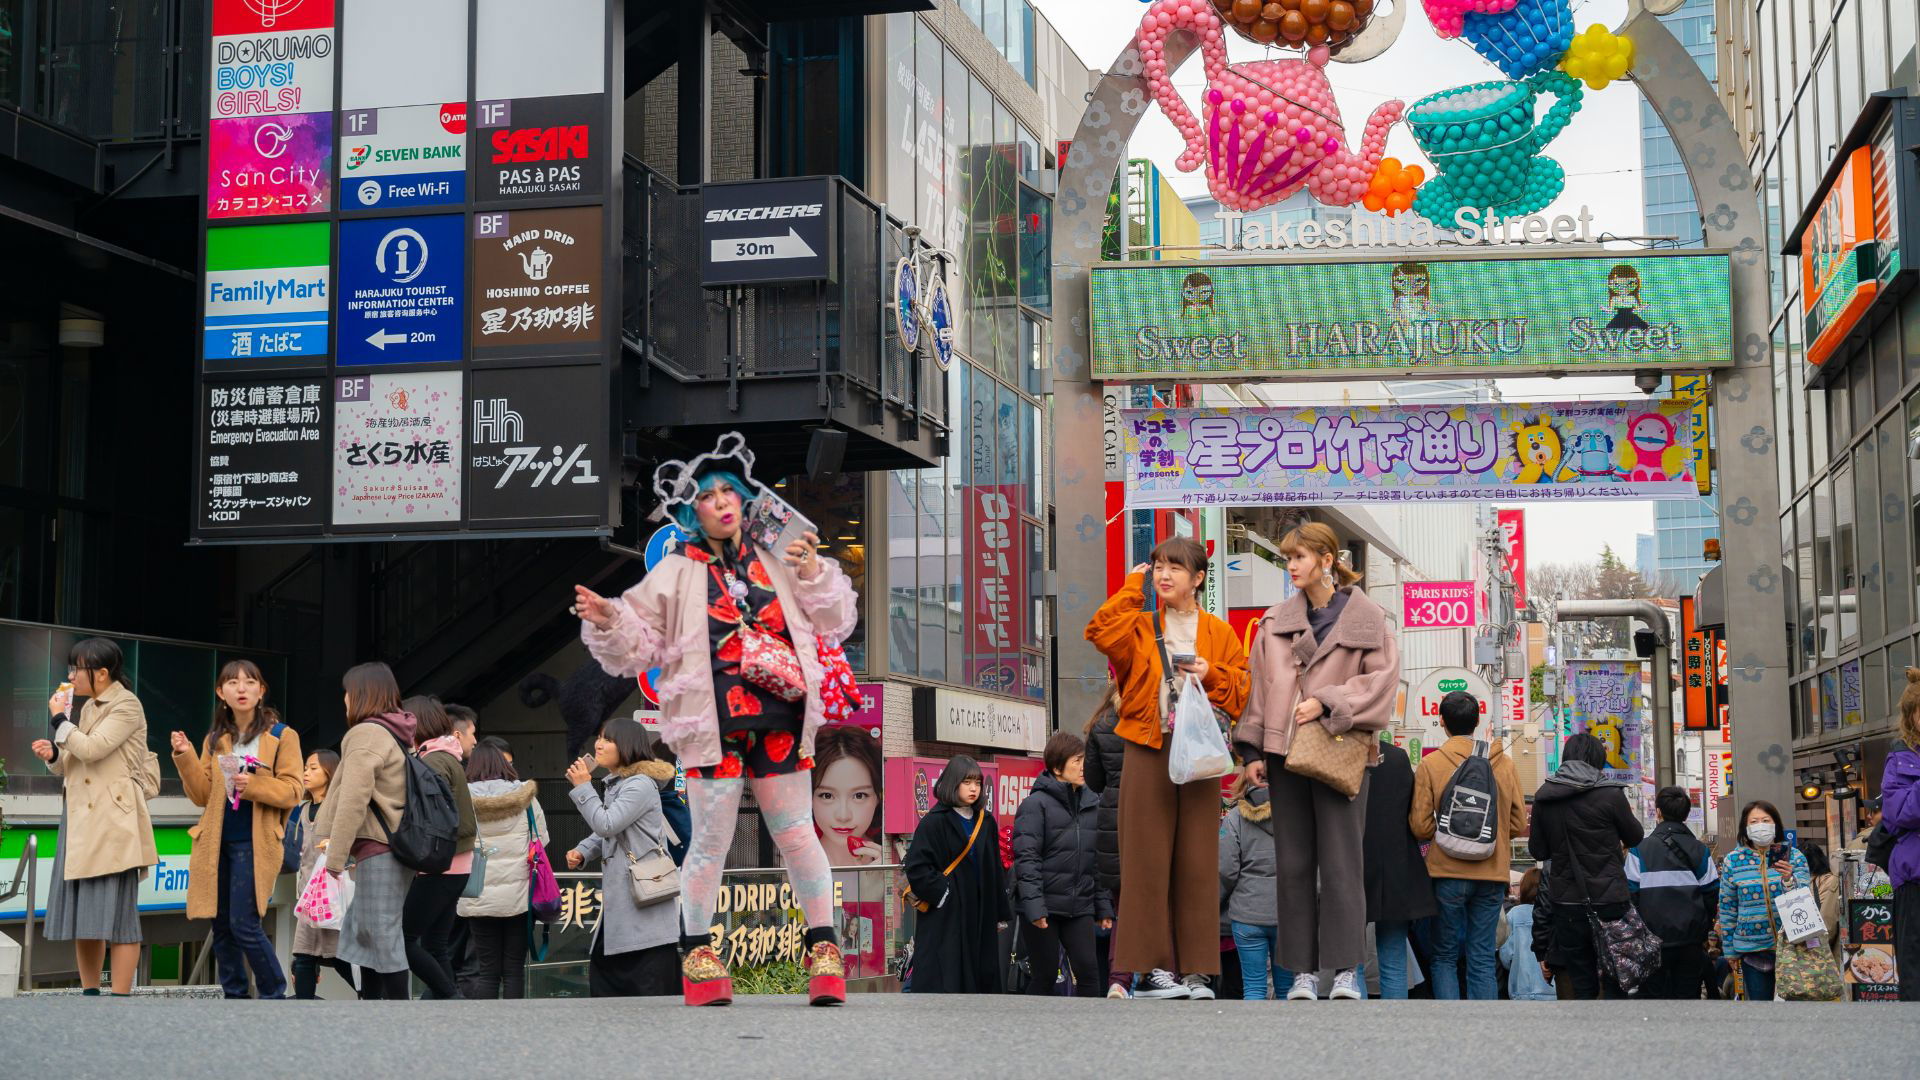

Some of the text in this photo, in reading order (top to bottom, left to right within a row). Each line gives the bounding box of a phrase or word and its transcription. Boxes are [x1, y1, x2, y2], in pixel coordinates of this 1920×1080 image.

[218, 34, 332, 65] DOKUMO
[217, 62, 294, 91] BOYS!
[217, 87, 302, 116] GIRLS!
[348, 113, 368, 132] 1F
[481, 103, 505, 125] 1F
[375, 144, 462, 163] SEVEN BANK
[491, 125, 589, 165] SASAKI
[220, 165, 320, 188] SanCity
[499, 165, 581, 185] PAS à PAS
[388, 181, 450, 199] Free Wi-Fi
[499, 182, 580, 195] HARAJUKU SASAKI
[704, 203, 823, 223] SKECHERS
[480, 214, 503, 235] BF
[1213, 204, 1597, 250] Takeshita Street
[502, 229, 575, 252] HAND DRIP
[735, 242, 775, 257] 30m
[210, 278, 326, 306] FamilyMart
[355, 285, 447, 299] HARAJUKU TOURIST
[486, 283, 590, 299] HOSHINO COFFEE
[347, 296, 455, 311] INFORMATION CENTER
[480, 301, 596, 336] 星乃珈琲
[231, 331, 303, 357] 酒 たばこ
[410, 331, 436, 343] 20m
[1137, 316, 1682, 365] Sweet HARAJUKU Sweet
[210, 384, 321, 408] 防災備蓄倉庫
[342, 378, 365, 398] BF
[210, 426, 320, 446] Emergency Evacuation Area
[1104, 394, 1117, 470] CAT CAFE
[1133, 418, 1177, 435] ドコモ
[1148, 435, 1163, 448] の
[1187, 410, 1499, 479] 星プロ竹下通り
[346, 440, 451, 466] さくら水産
[1139, 448, 1175, 468] 学割
[1138, 468, 1180, 481] presents
[1410, 585, 1469, 599] PARIS KID'S
[1409, 601, 1469, 625] ¥300
[950, 707, 1021, 735] CAT CAFE MOCHA
[1708, 753, 1719, 811] PURIKURA
[734, 883, 777, 912] DRIP
